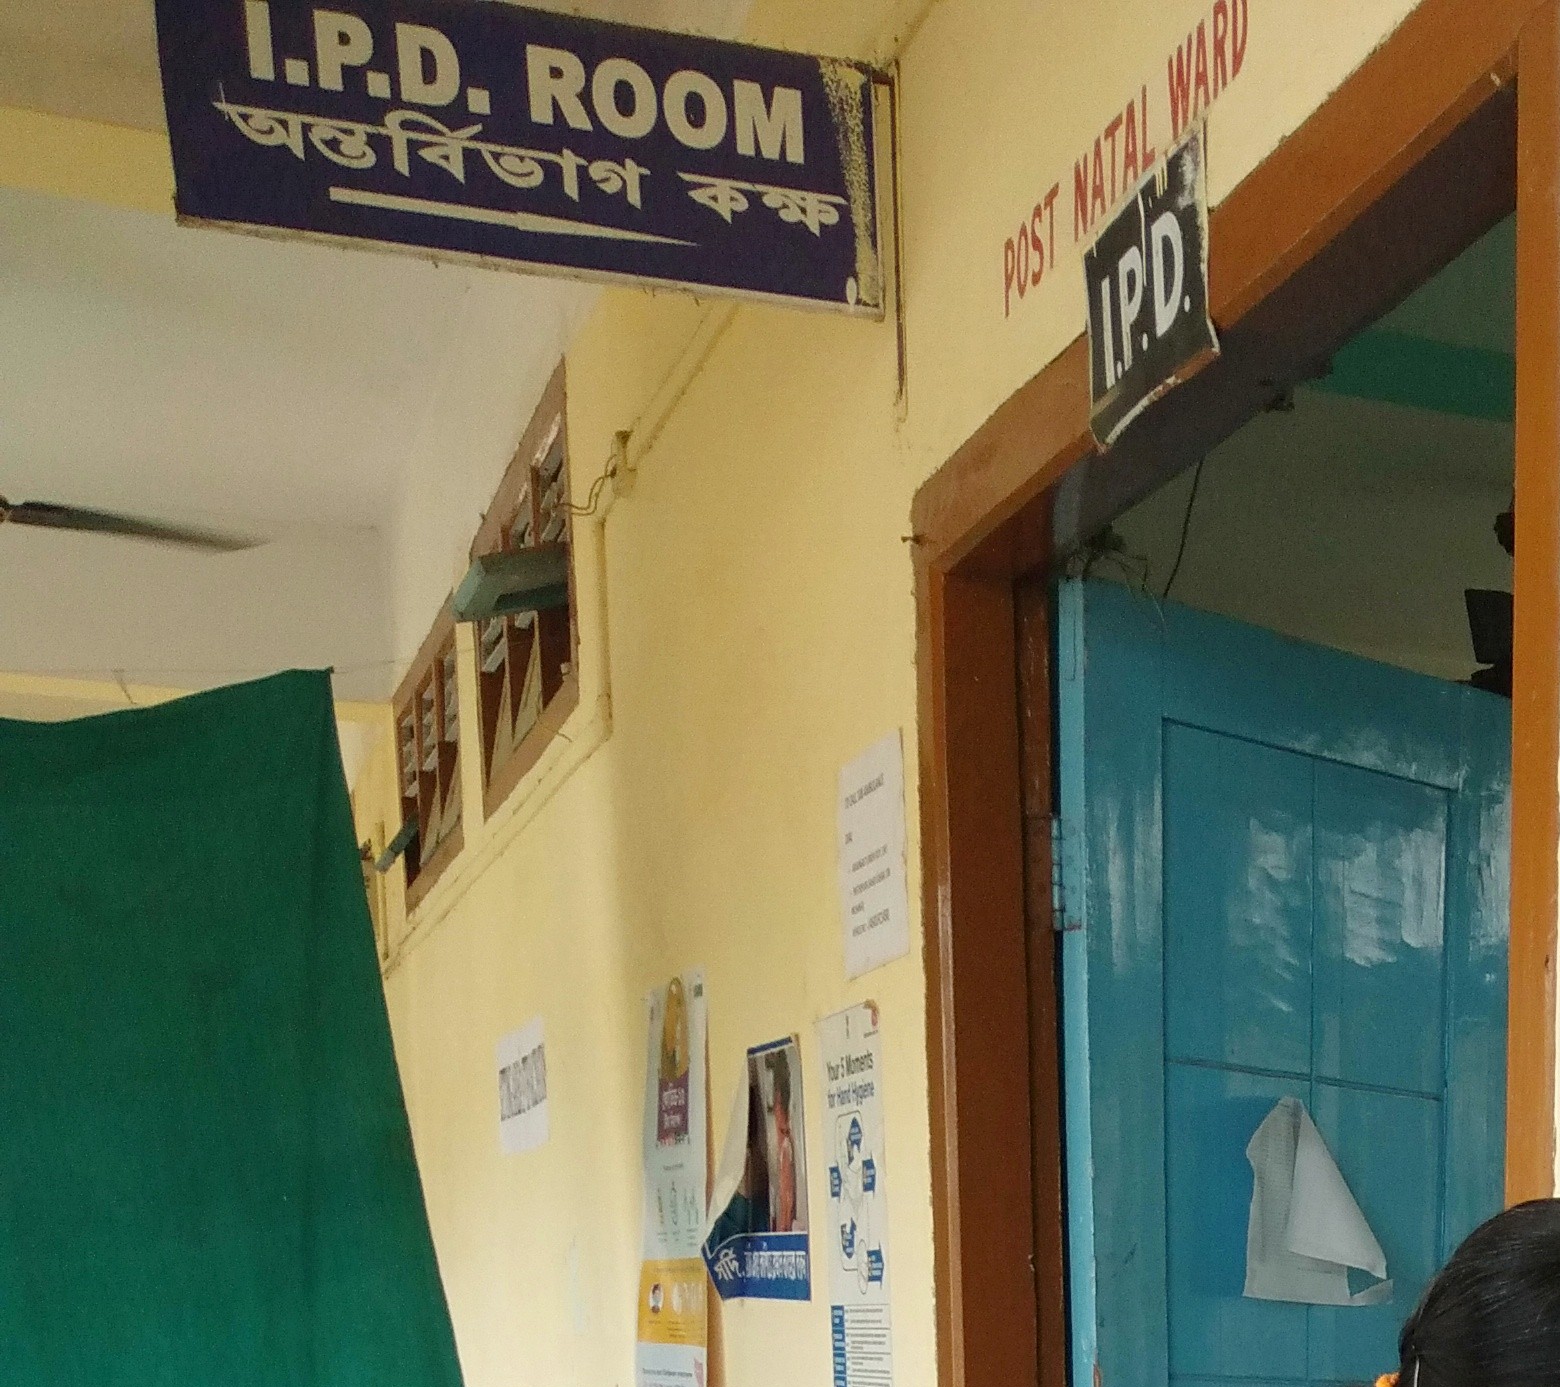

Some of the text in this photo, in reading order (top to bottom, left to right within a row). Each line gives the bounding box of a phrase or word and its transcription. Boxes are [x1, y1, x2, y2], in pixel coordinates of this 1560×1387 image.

[246, 0, 805, 164] I.P.D. ROOM
[1003, 0, 1249, 318] POST NATAL WARD
[681, 171, 847, 235] কক্ষ
[1101, 210, 1191, 391] I.P.D.
